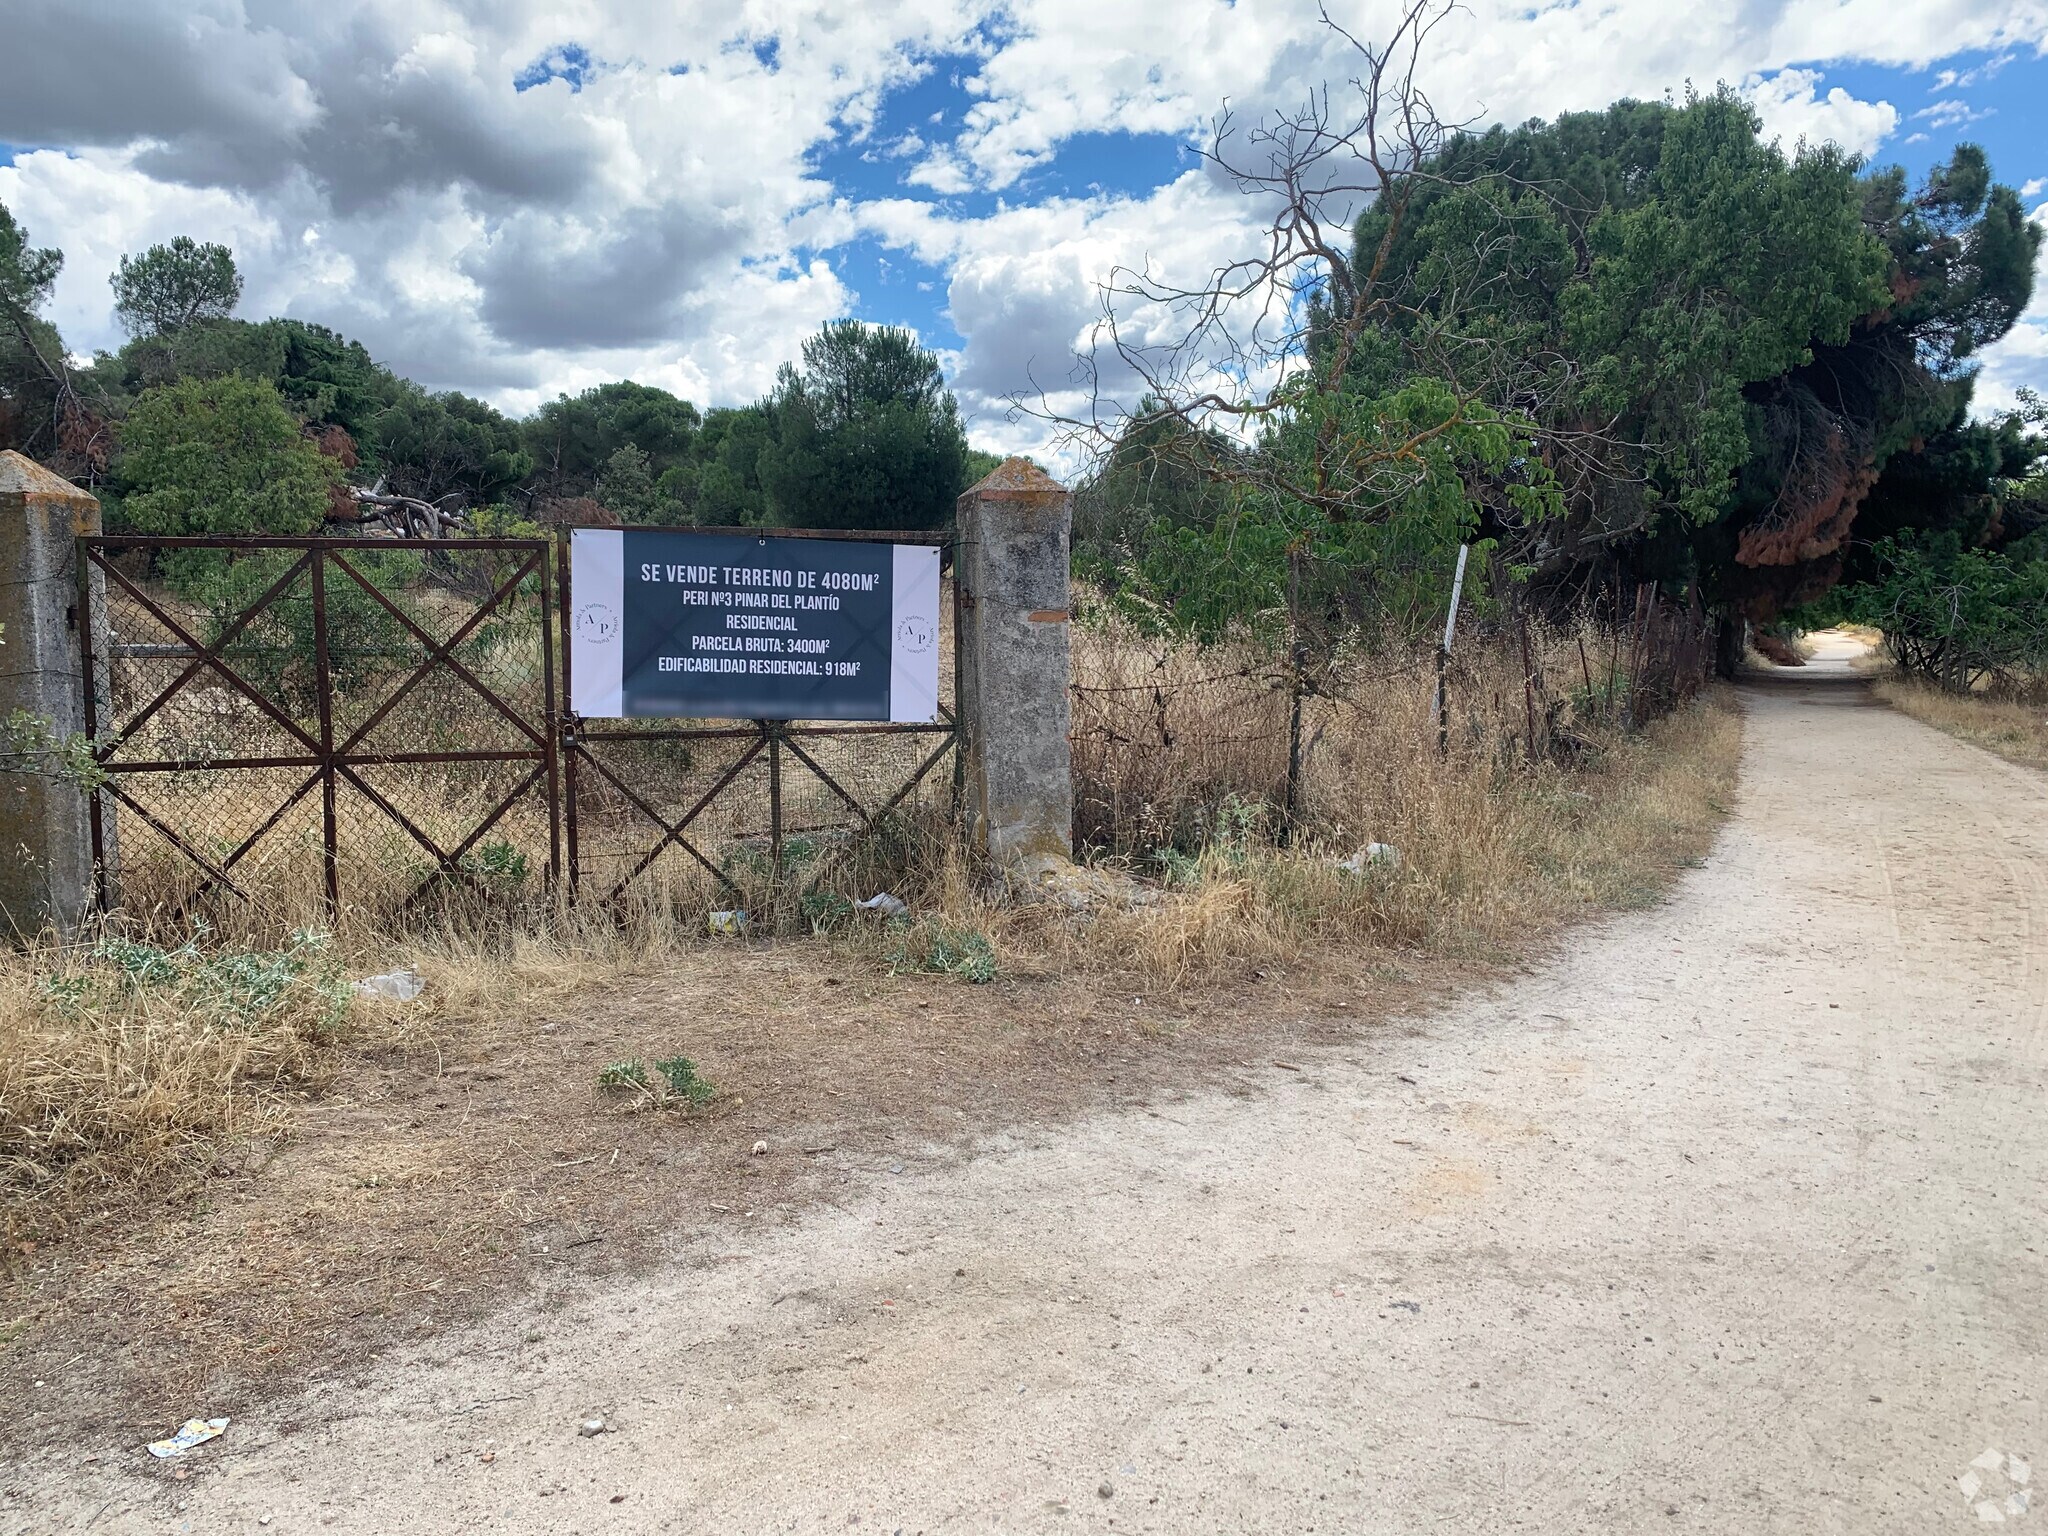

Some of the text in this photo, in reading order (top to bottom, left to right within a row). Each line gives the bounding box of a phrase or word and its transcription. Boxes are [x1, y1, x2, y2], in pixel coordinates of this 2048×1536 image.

[641, 563, 880, 591] SE VENDE TERRENO DE 4080M²
[683, 590, 840, 611] PERI Nº3 PINAR DEL PLANTÍO
[600, 622, 609, 634] P
[726, 614, 798, 631] RESIDENCIAL
[692, 635, 830, 654] PARCELA BRUTA: 3400M²
[918, 634, 926, 644] P
[658, 656, 861, 677] EDIFICABILIDAD RESIDENCIAL: 918M²
